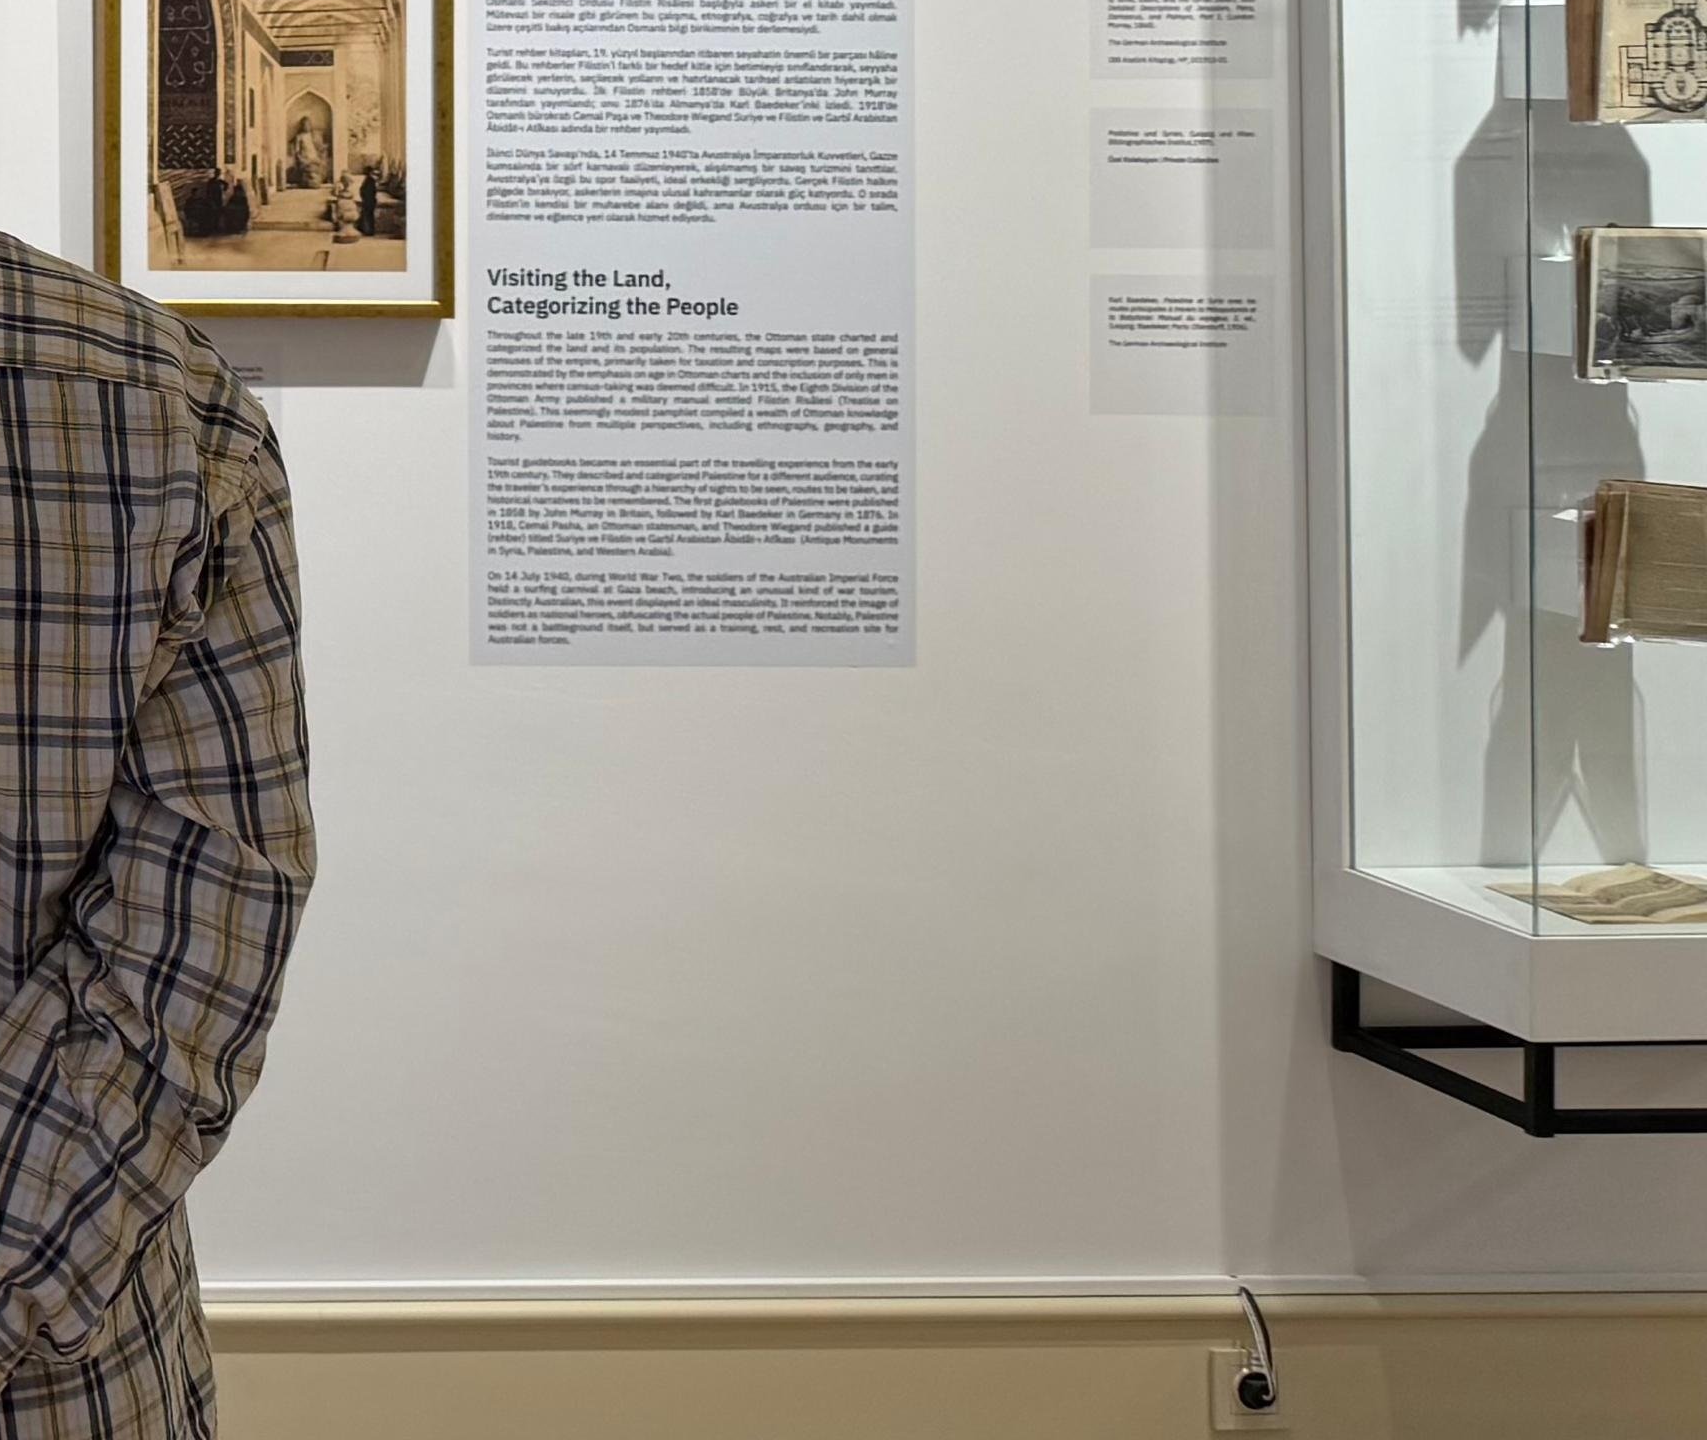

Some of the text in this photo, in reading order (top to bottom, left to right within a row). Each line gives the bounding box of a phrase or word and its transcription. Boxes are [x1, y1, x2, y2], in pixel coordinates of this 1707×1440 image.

[487, 267, 671, 292] Visiting the Land,
[487, 295, 739, 320] Categorizing the People
